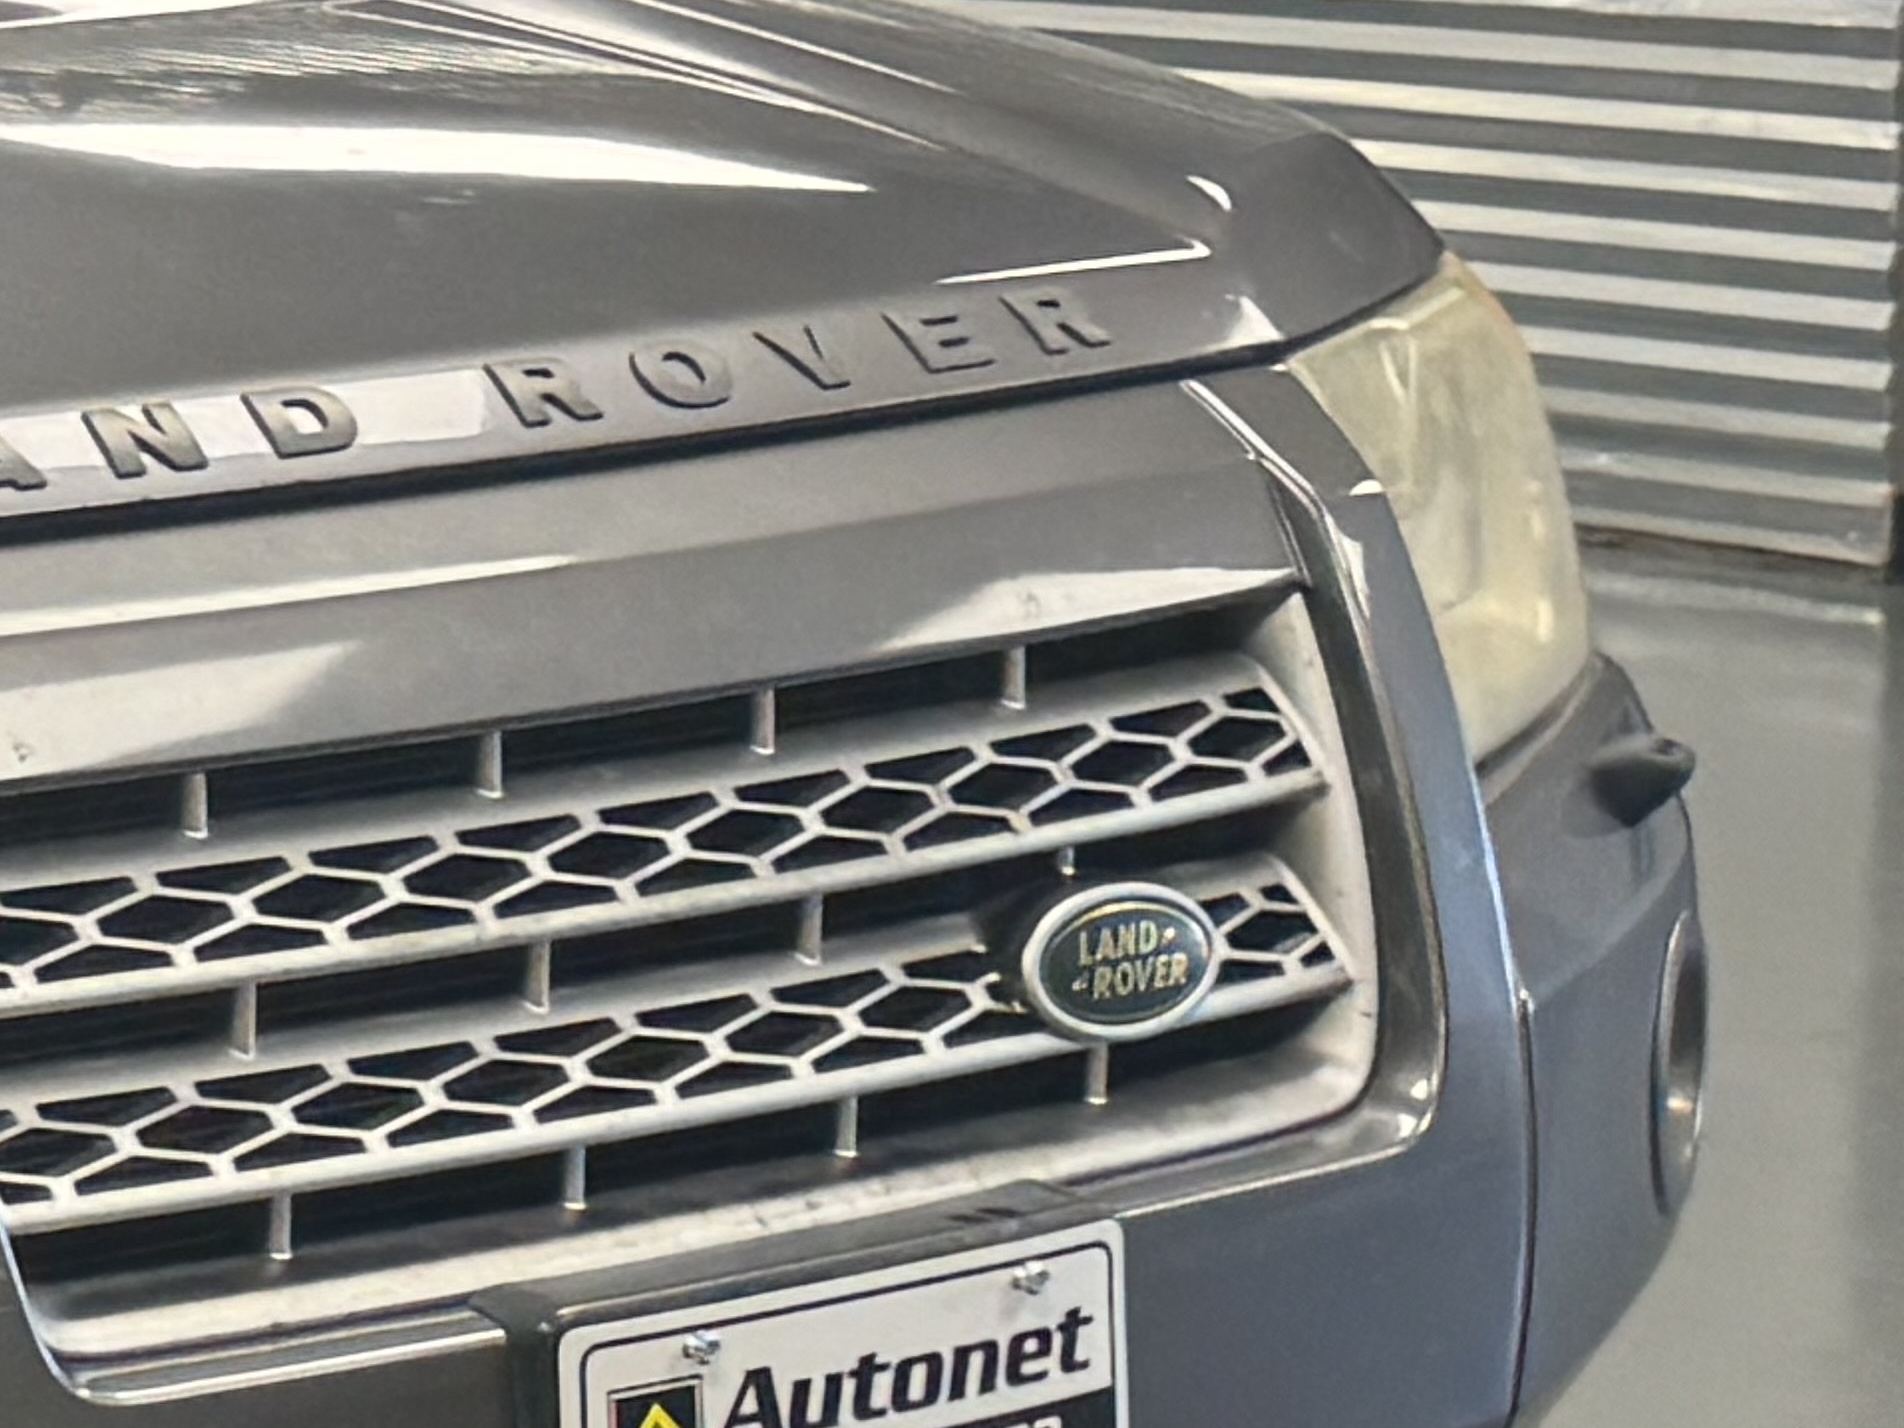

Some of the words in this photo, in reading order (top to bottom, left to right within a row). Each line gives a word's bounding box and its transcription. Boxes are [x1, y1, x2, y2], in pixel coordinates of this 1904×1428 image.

[482, 289, 1111, 429] ROVER
[1077, 919, 1160, 967] LAND
[1092, 951, 1190, 1001] ROVER
